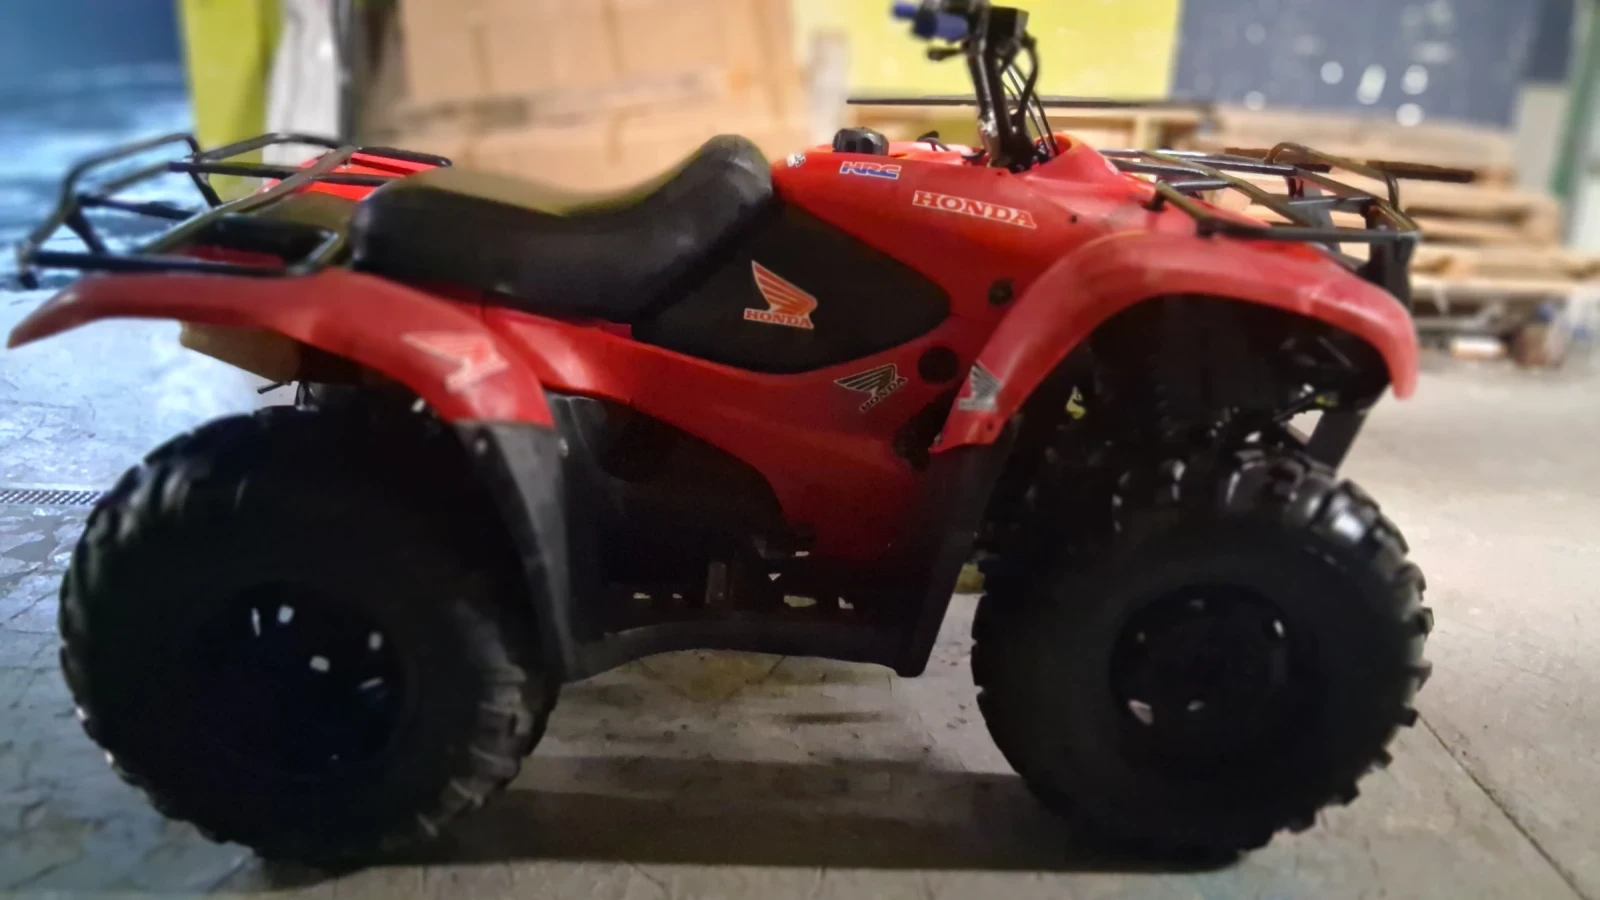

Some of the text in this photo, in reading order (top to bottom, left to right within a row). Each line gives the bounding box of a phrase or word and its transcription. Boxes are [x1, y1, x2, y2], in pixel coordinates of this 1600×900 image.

[841, 162, 900, 178] HRC
[914, 191, 1036, 228] HONDA
[745, 309, 813, 328] HONDA
[861, 377, 907, 412] HONDA
